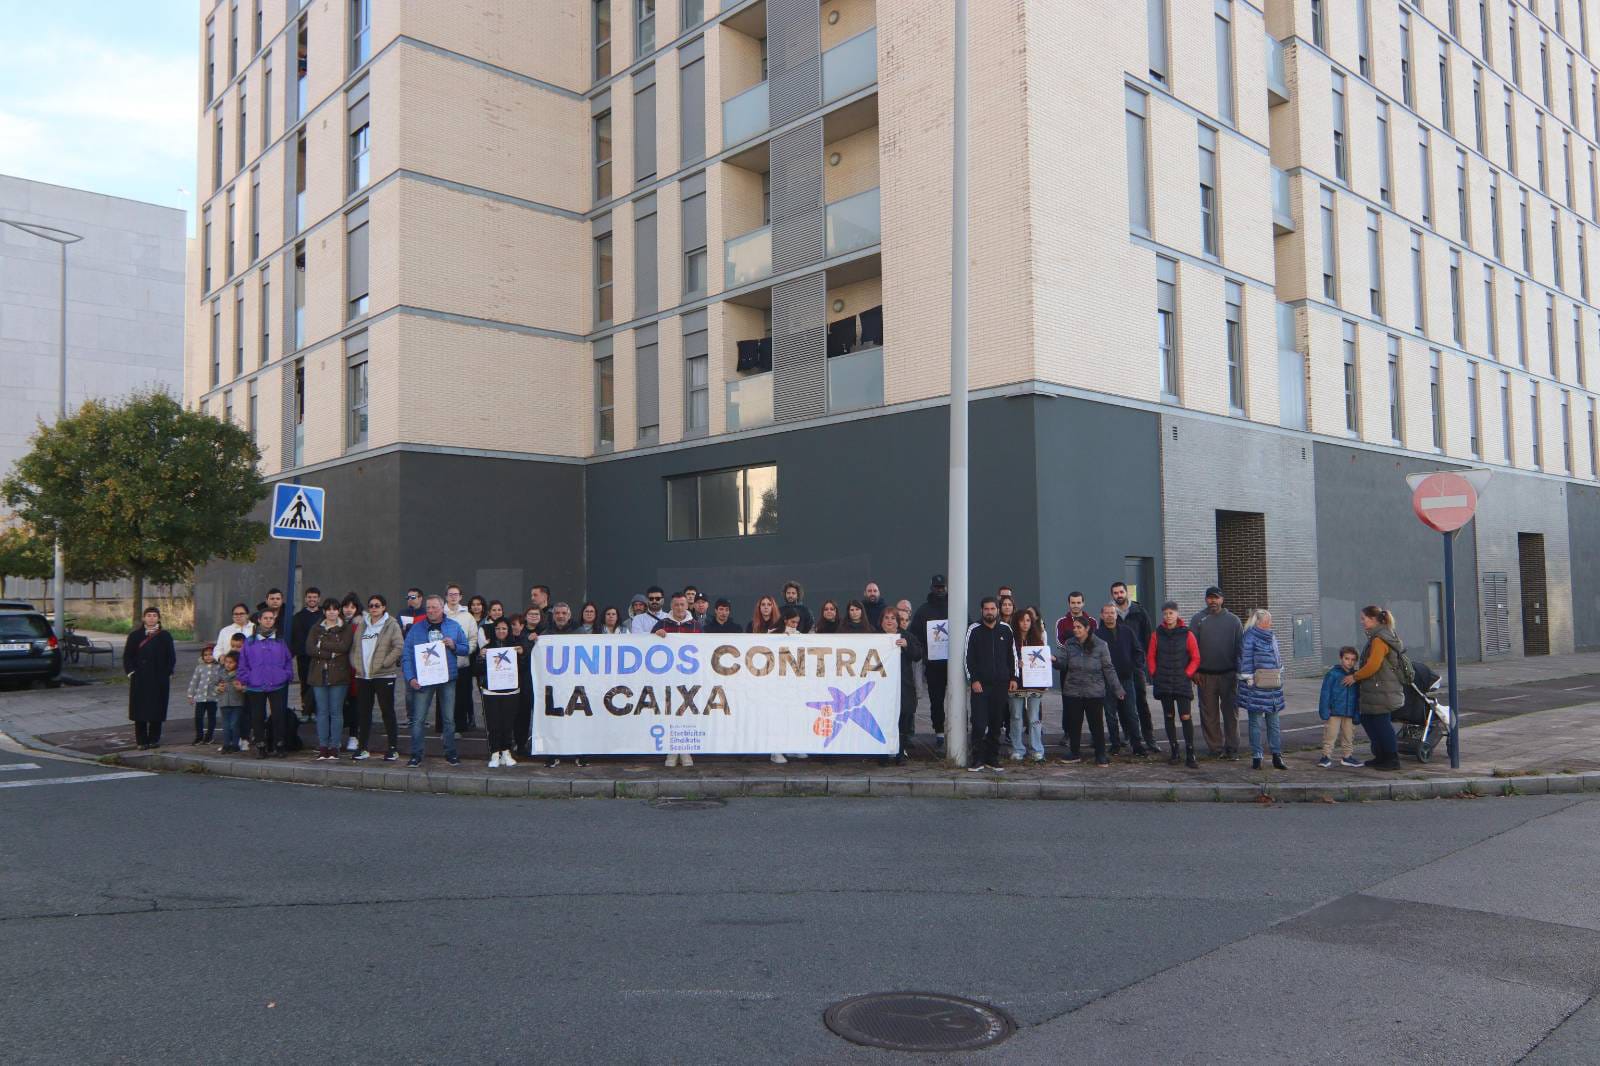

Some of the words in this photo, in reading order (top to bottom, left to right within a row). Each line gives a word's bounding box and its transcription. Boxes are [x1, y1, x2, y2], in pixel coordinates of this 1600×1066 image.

[546, 645, 699, 675] UNIDOS
[711, 645, 886, 677] CONTRA
[545, 686, 593, 717] LA
[603, 685, 730, 716] CAIXA
